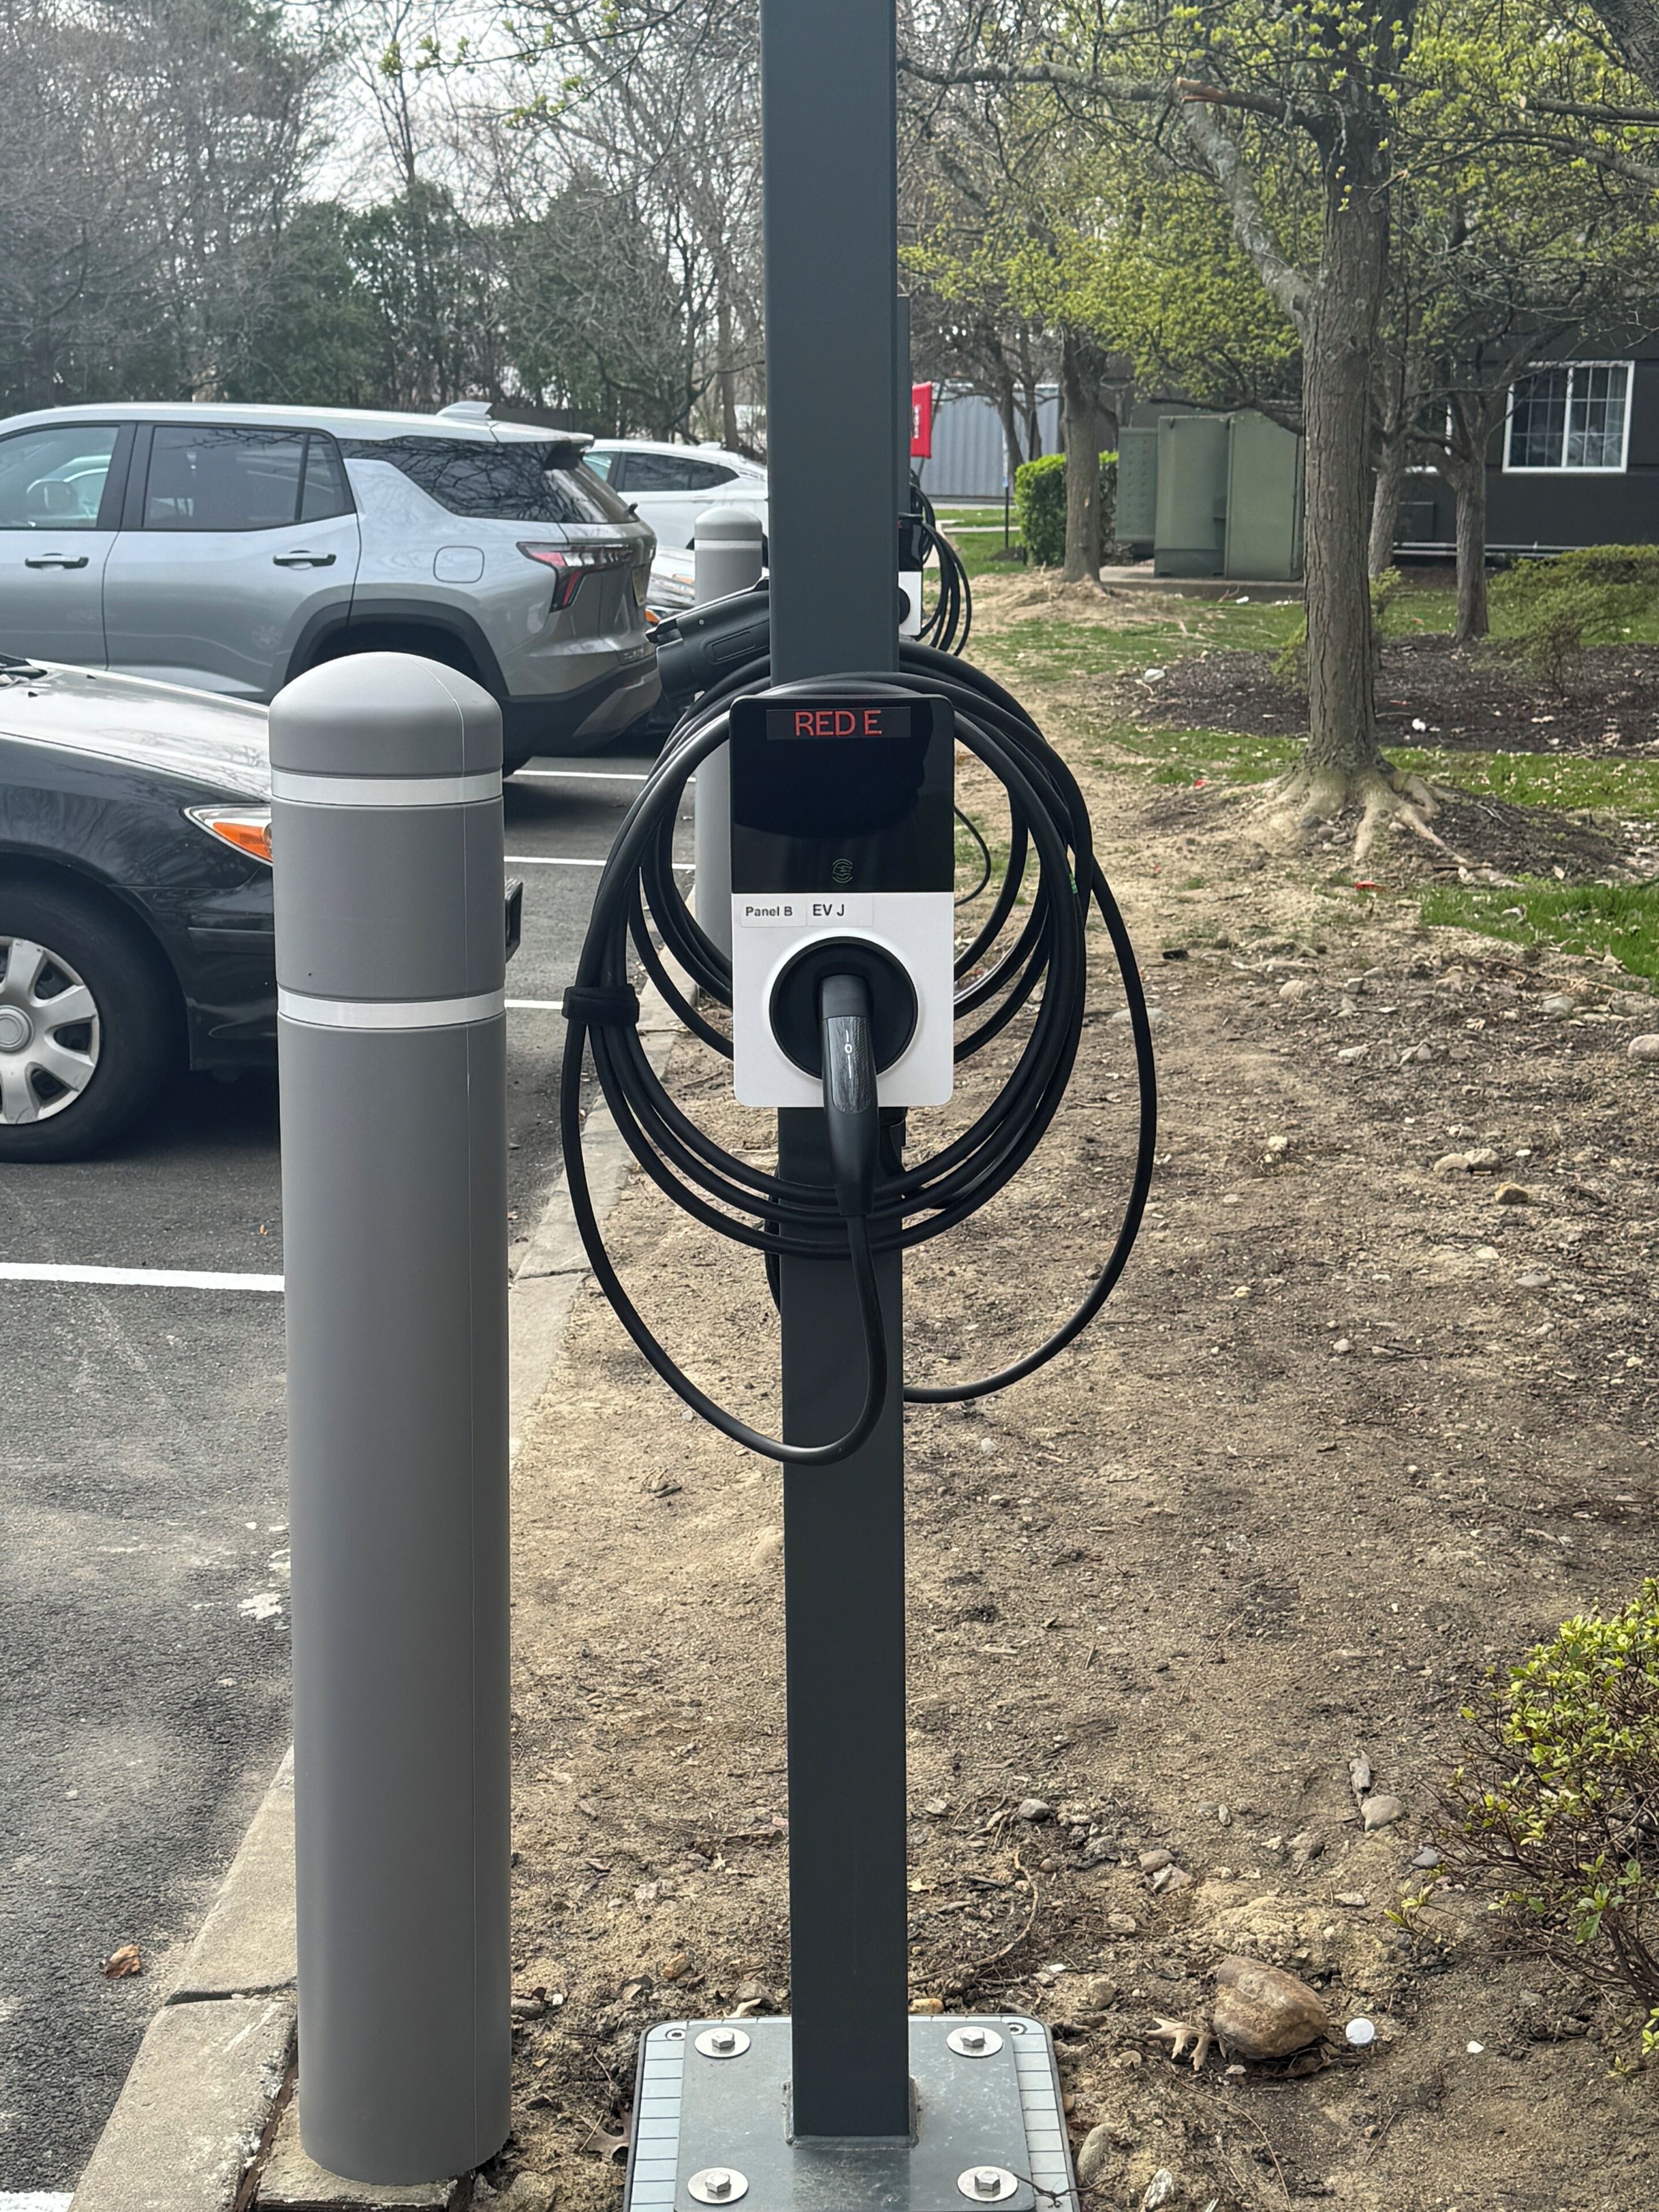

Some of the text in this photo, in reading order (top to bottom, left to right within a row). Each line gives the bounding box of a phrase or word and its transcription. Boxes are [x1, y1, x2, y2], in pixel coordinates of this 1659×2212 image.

[794, 709, 882, 736] RED E
[745, 906, 793, 916] Panel B
[813, 904, 844, 916] EV J
